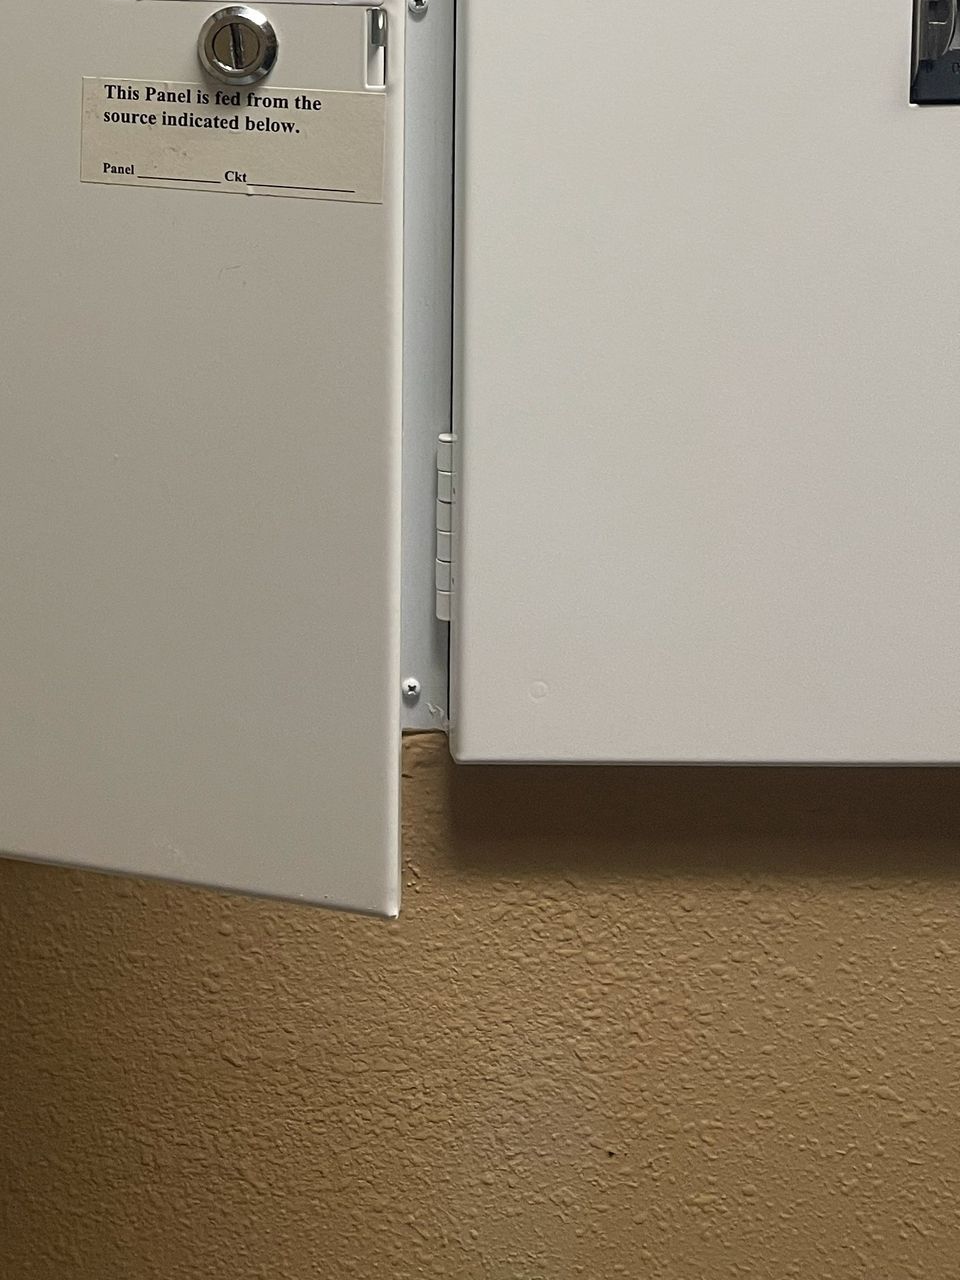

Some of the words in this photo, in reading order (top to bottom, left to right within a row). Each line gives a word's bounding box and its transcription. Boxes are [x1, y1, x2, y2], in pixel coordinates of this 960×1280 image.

[104, 84, 140, 102] This
[145, 86, 191, 104] Panel
[196, 89, 209, 105] is
[215, 90, 240, 107] fed
[246, 91, 289, 110] from
[295, 94, 322, 111] the
[103, 110, 157, 125] source
[161, 111, 239, 130] indicated
[245, 116, 301, 134] below.
[103, 162, 135, 175] Panel
[224, 170, 247, 183] Ckt
